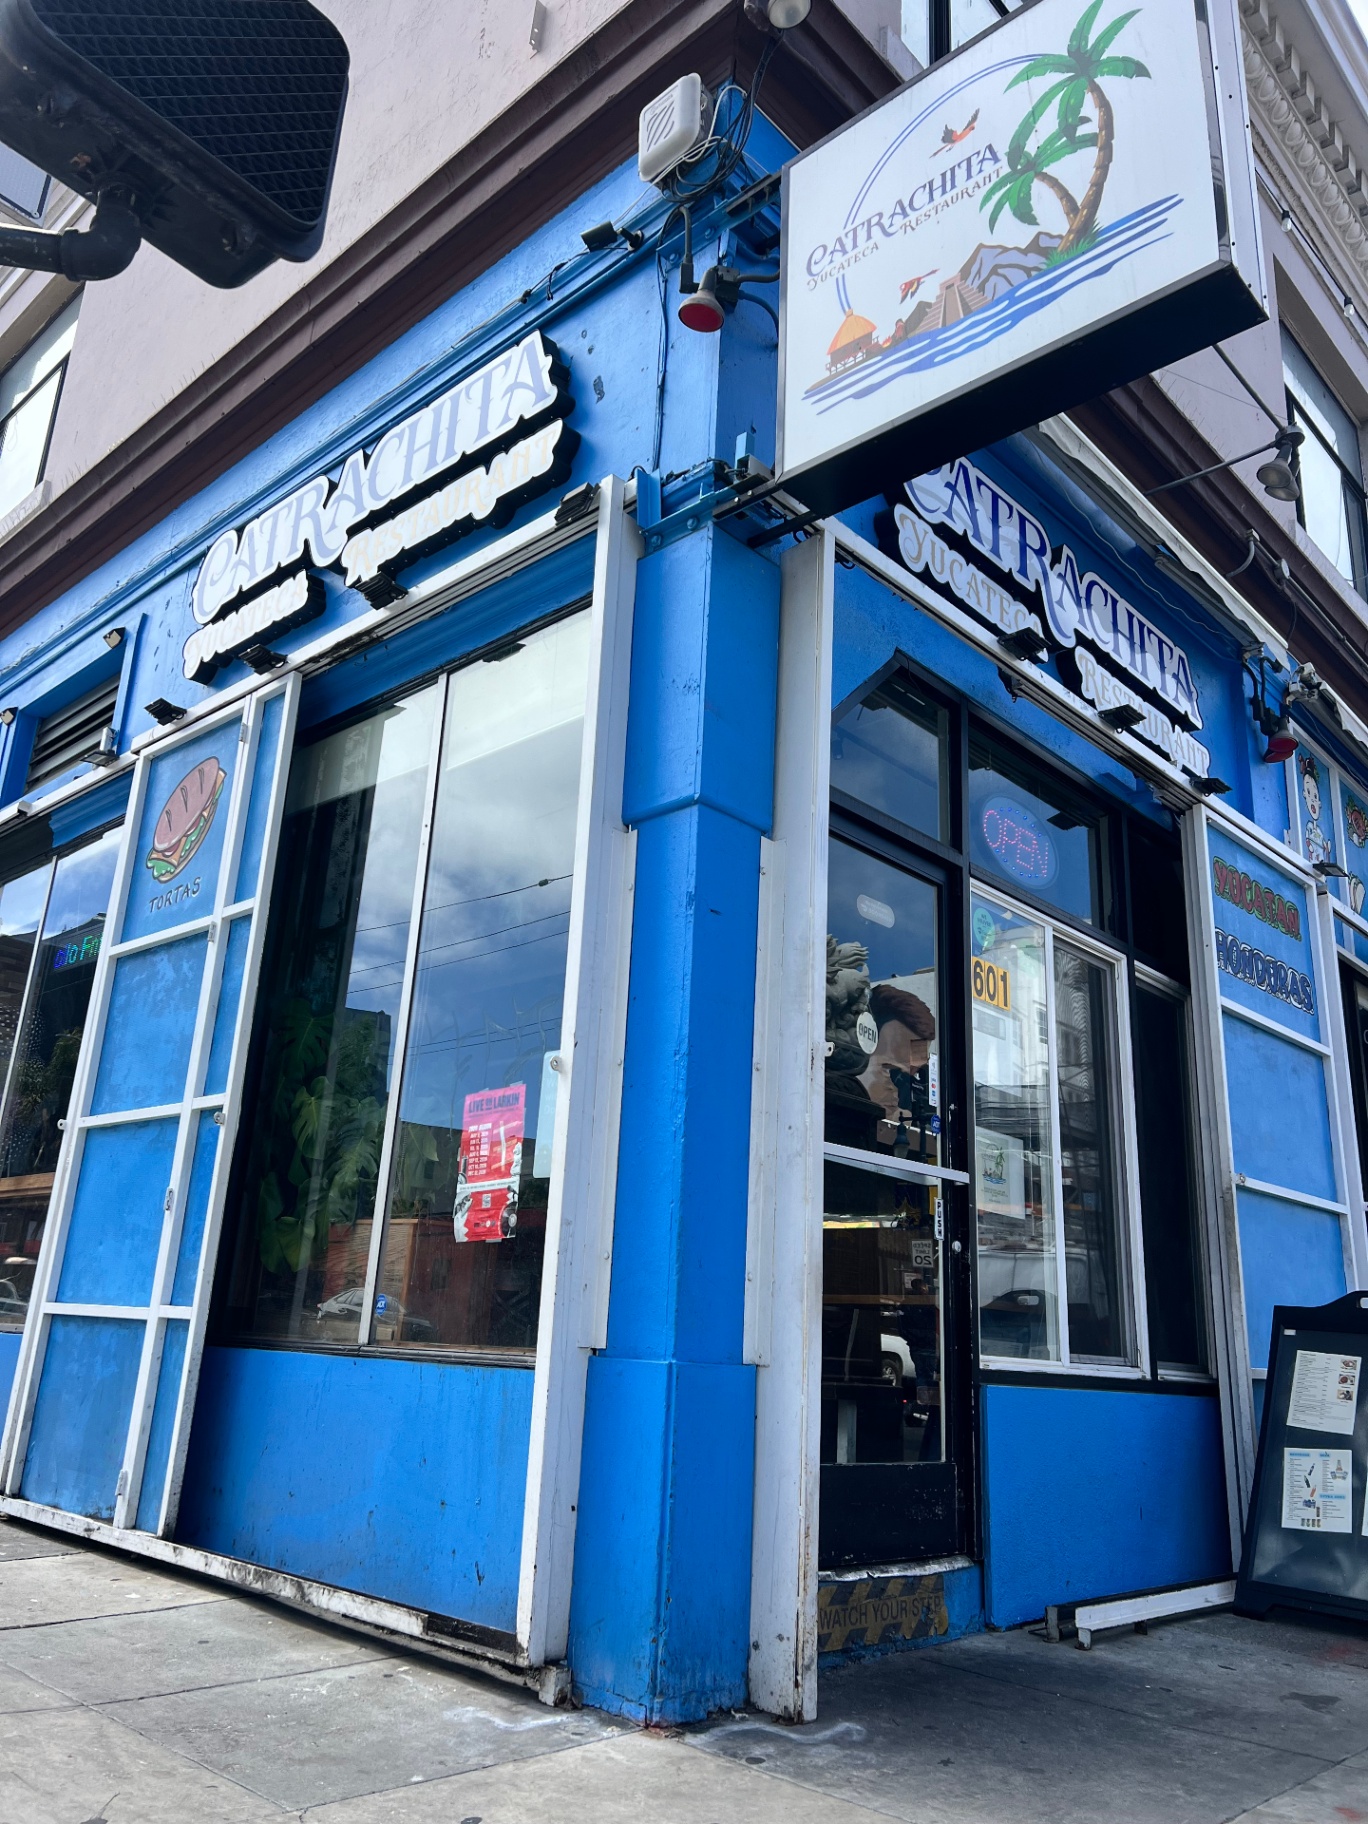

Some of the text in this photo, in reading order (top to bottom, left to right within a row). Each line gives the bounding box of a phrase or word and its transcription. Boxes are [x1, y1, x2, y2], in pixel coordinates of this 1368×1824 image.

[806, 143, 1001, 277] CATRACHITA
[807, 242, 879, 291] YUCATECA
[197, 337, 553, 617] CATRACHITA
[187, 578, 305, 673] YUCATECA
[983, 809, 1048, 877] OPEN
[149, 876, 202, 914] TORTAS
[1213, 856, 1302, 942] YUCATAN
[973, 960, 1008, 1008] 601
[1215, 926, 1314, 1016] HONDURAS
[859, 1022, 877, 1044] OPEN
[468, 1099, 485, 1113] LIVE
[493, 1092, 520, 1109] LARKIN
[820, 1602, 868, 1630] WATCH
[872, 1600, 908, 1623] YOUR
